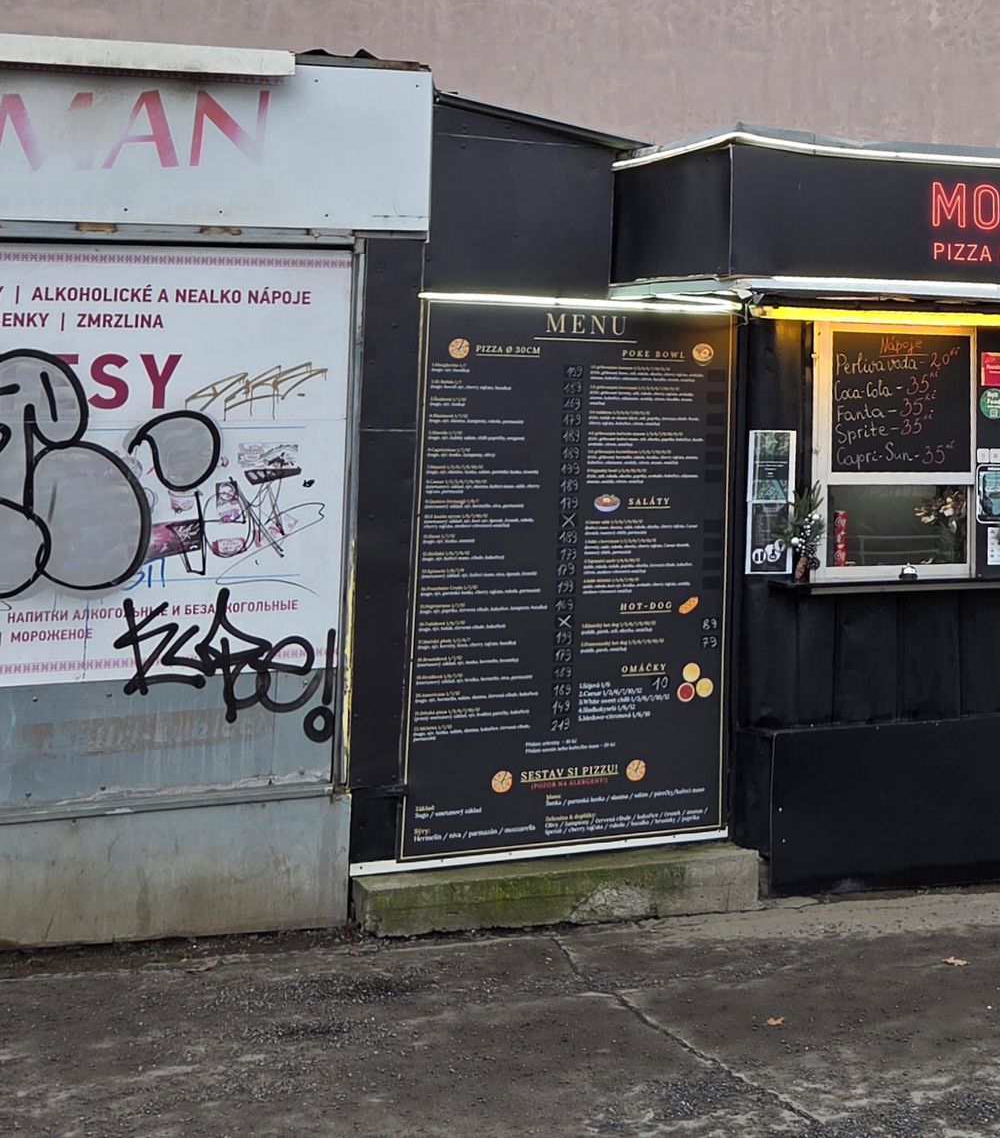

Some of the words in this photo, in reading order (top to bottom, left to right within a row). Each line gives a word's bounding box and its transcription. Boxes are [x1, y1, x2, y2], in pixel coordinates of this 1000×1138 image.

[932, 242, 992, 263] PIZZA
[31, 284, 152, 303] ALKOHOLICKÉ
[158, 288, 169, 303] A
[175, 288, 242, 304] NEALKO
[247, 286, 312, 305] NÁPOJE
[76, 313, 164, 329] ZMRZLINA
[545, 312, 628, 336] MENU
[475, 344, 503, 354] PIZZA
[515, 346, 541, 355] 30CM
[880, 335, 923, 354] Nápoje
[621, 349, 651, 359] POKE
[655, 350, 686, 360] BOWL
[834, 379, 893, 402] Coca-Cola
[837, 404, 886, 422] Fanta
[835, 422, 888, 445] Sprite
[837, 442, 913, 470] Capri-Sun
[628, 496, 671, 506] SALÁTY
[7, 610, 68, 625] НАПИТКИ
[184, 599, 299, 616] БЕЗАКОГОЛЬНЫЕ
[620, 601, 672, 611] HOT-DOG
[11, 628, 93, 643] МОРОЖЕНОЕ
[621, 662, 667, 674] OMÁČKY
[652, 676, 669, 691] 10
[520, 768, 564, 781] SESTAV
[567, 766, 578, 777] SI
